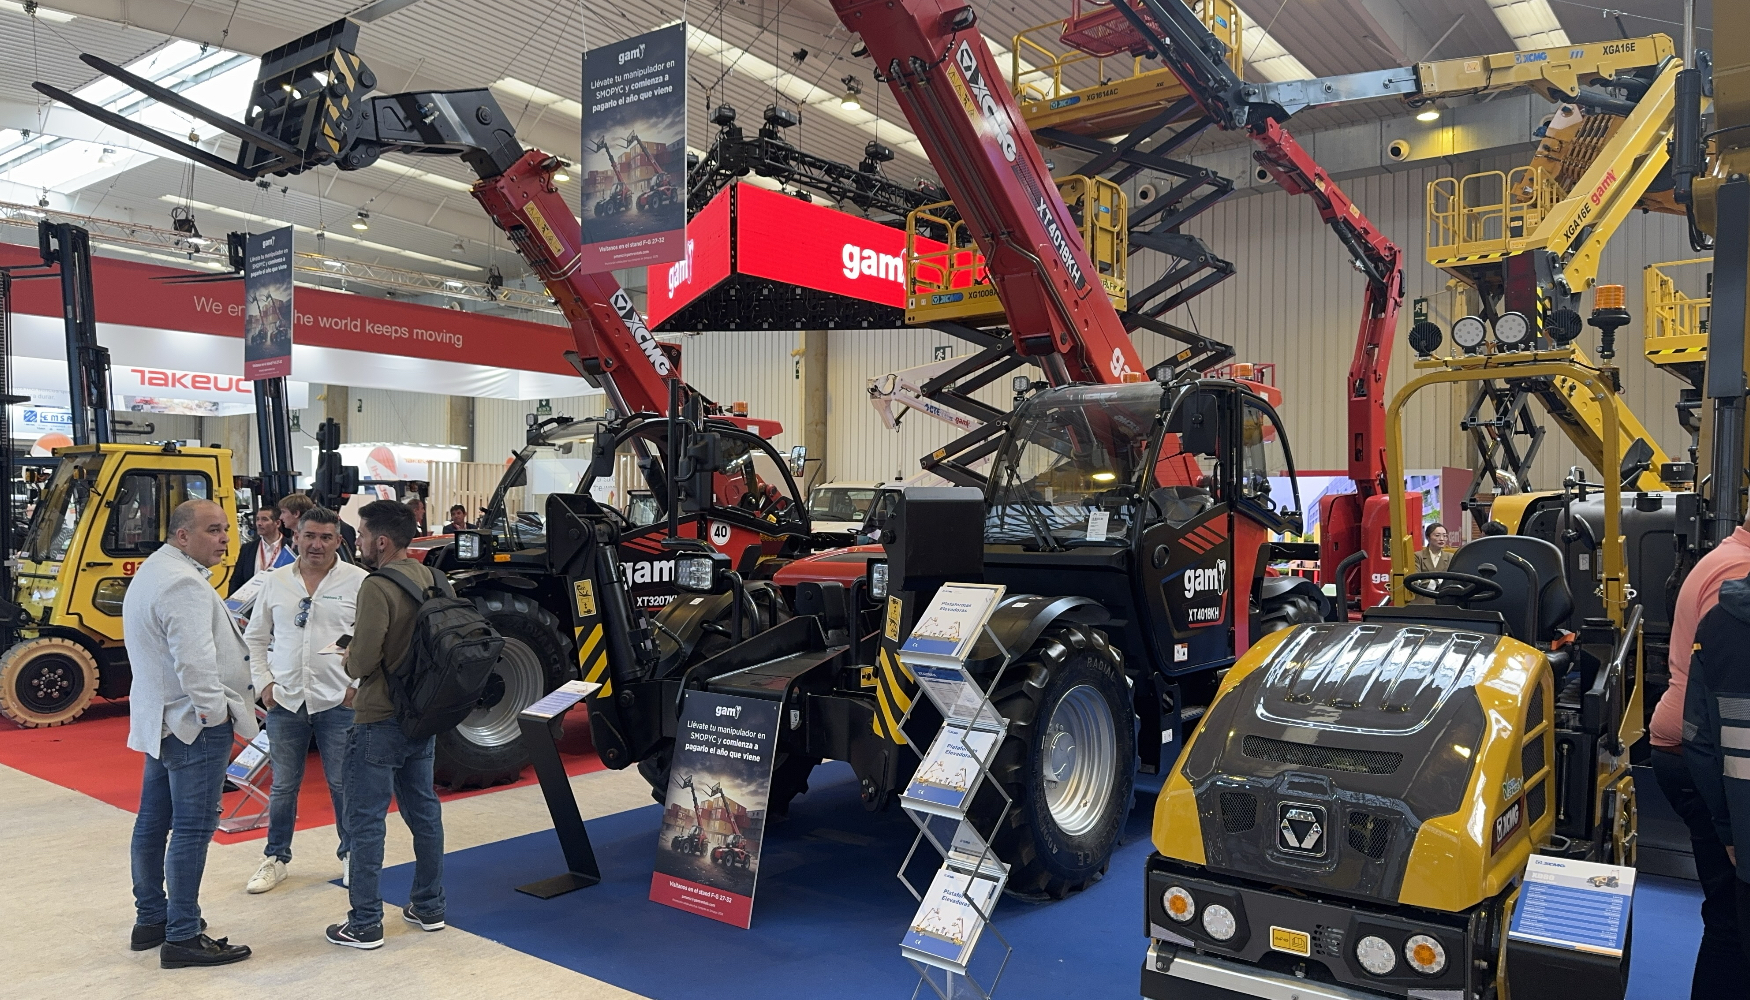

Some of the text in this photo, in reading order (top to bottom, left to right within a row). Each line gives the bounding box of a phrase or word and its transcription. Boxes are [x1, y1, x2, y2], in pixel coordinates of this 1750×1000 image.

[618, 47, 641, 65] gam
[1522, 52, 1547, 63] XCMG
[1602, 42, 1636, 56] XGA16E
[590, 60, 675, 90] Llévate tu manipulador en
[596, 85, 624, 100] SMOPYC
[625, 85, 630, 93] y
[630, 76, 663, 90] comienza
[592, 85, 673, 114] pagarlo el año que viene
[1563, 202, 1592, 243] XGA16E
[194, 295, 223, 315] We
[293, 310, 314, 327] he
[318, 316, 361, 333] world
[365, 319, 409, 339] keeps
[413, 329, 463, 348] moving
[621, 311, 670, 376] XCMG
[714, 525, 728, 538] 40
[1183, 567, 1219, 599] gam
[1371, 572, 1390, 584] ga
[636, 594, 678, 607] XT3207K
[1188, 606, 1220, 622] XT4018KH
[715, 705, 736, 717] gam
[687, 720, 766, 740] Llévate tu manipulador en
[690, 731, 717, 743] SMOPYC
[717, 737, 722, 745] y
[722, 739, 753, 749] comienza
[946, 743, 978, 753] Plataforas
[684, 743, 709, 753] pagarlo
[716, 747, 728, 757] año
[729, 750, 742, 759] que
[742, 753, 761, 763] viene
[1502, 803, 1520, 838] XCMG
[942, 888, 975, 901] Plataforas
